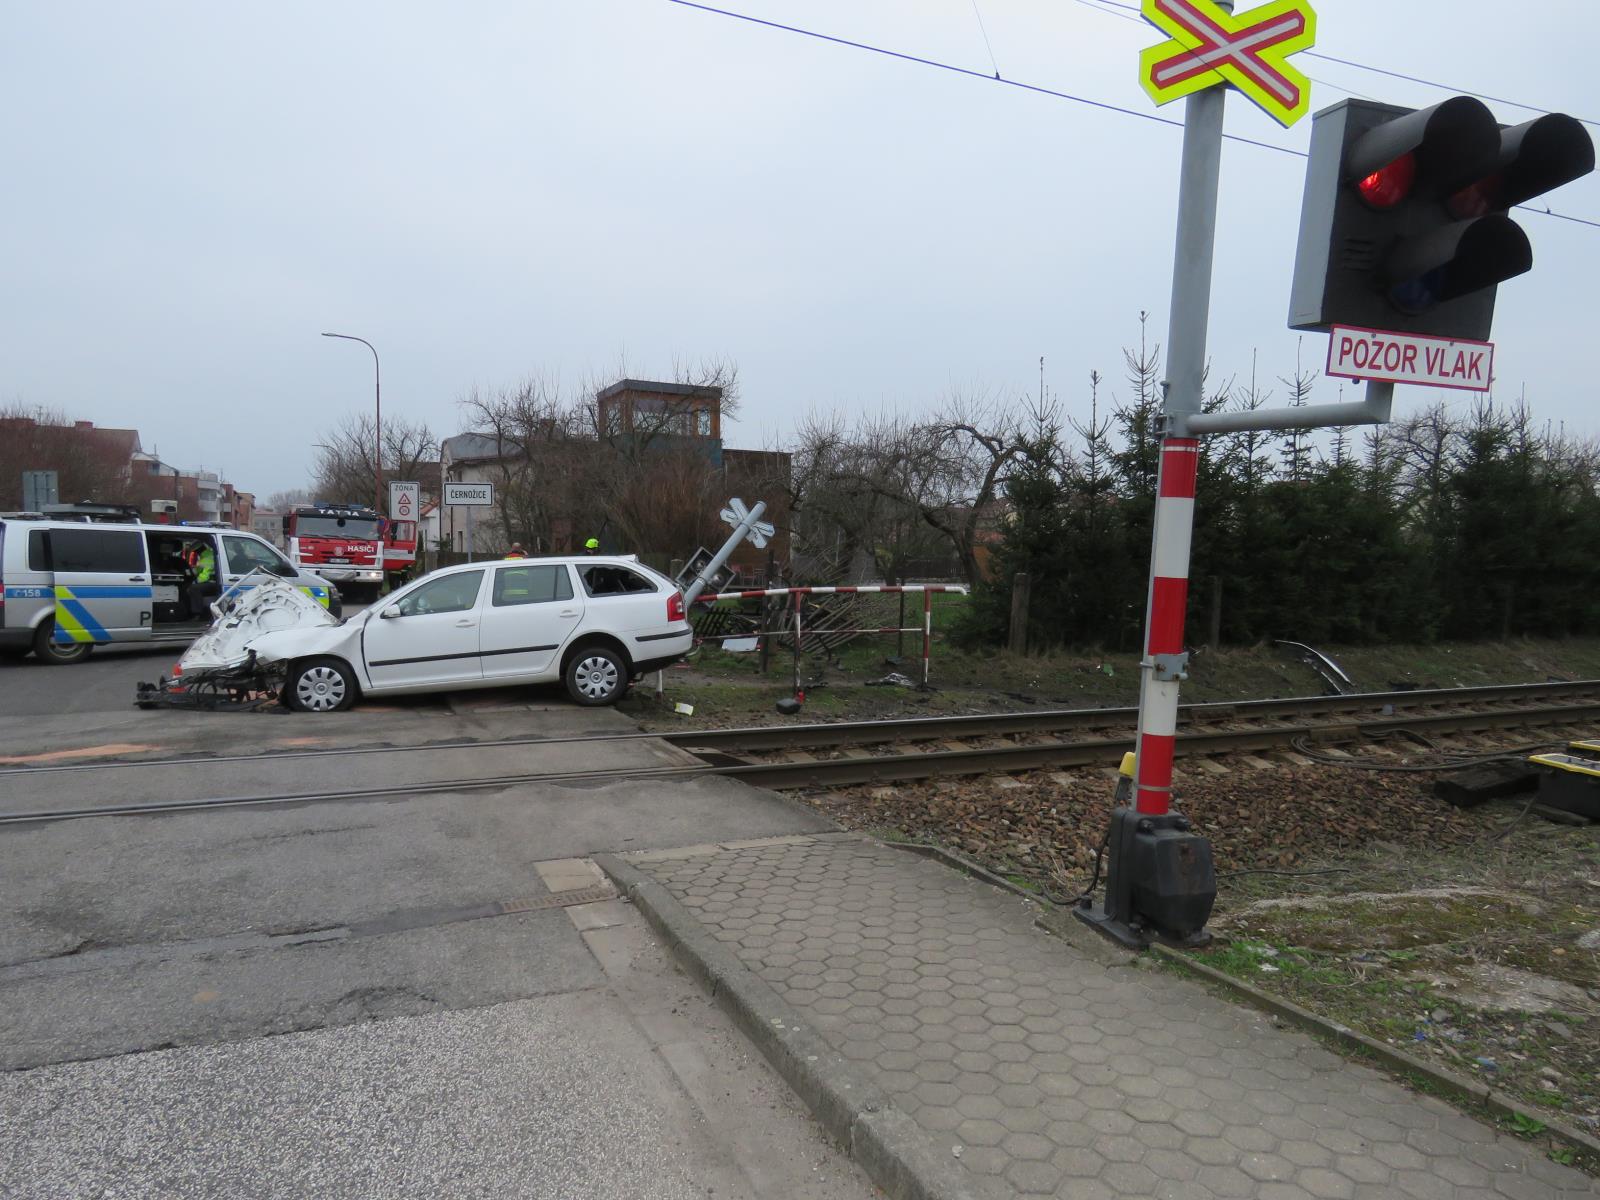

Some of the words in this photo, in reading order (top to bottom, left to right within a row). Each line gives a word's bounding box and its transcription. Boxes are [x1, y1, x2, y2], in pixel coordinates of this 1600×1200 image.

[1338, 336, 1417, 374] POZOR
[1425, 346, 1484, 381] VLAK
[450, 489, 487, 499] ČERNOŽICE
[24, 589, 41, 598] 158
